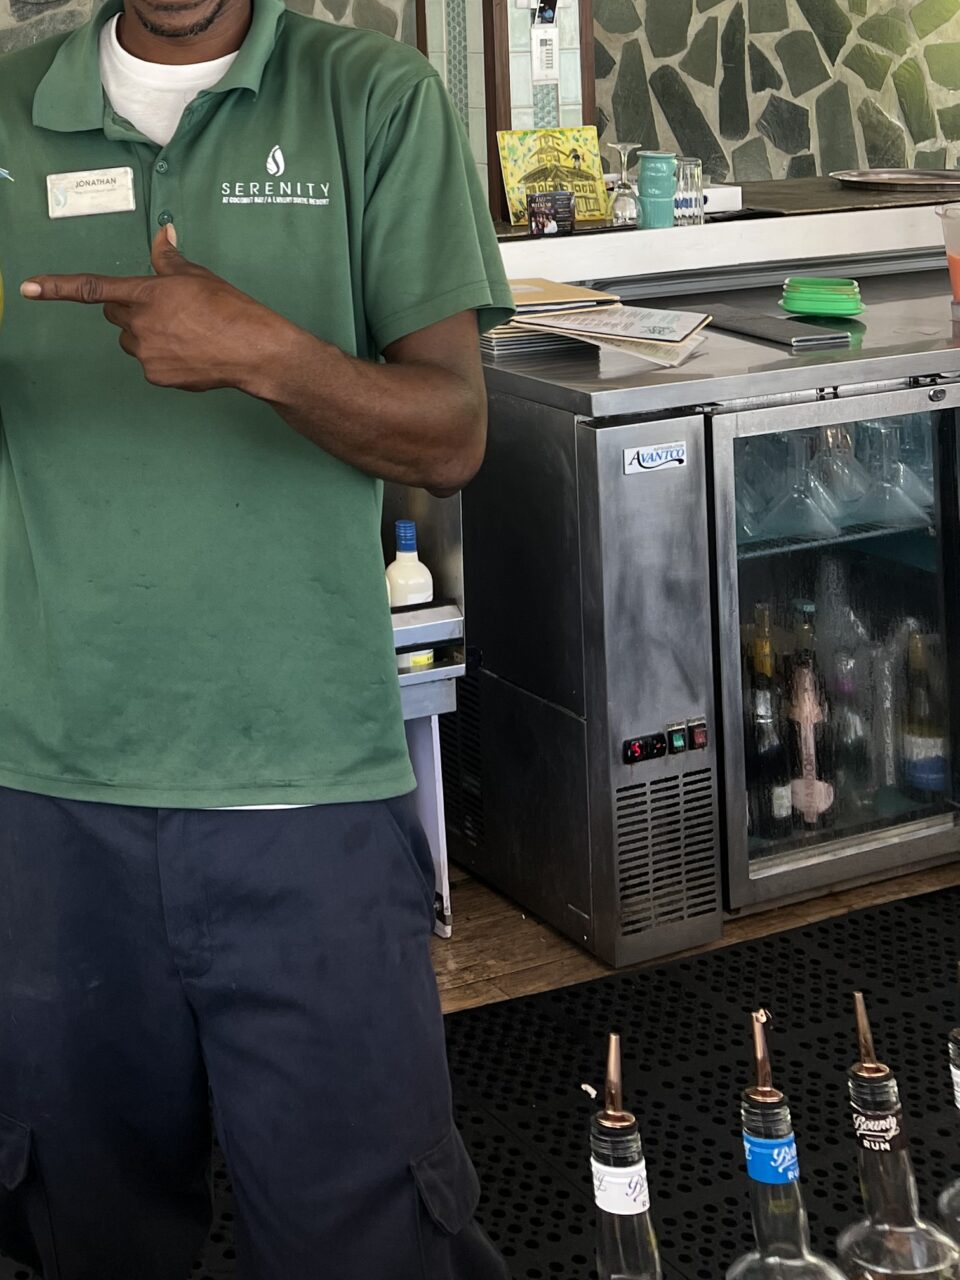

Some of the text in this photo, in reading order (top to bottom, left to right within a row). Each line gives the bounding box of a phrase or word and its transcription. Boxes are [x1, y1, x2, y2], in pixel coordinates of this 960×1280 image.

[75, 177, 117, 188] JONATHAN
[221, 181, 330, 197] SERENITY
[628, 447, 685, 469] AVANTCO
[852, 1114, 900, 1140] Bounty
